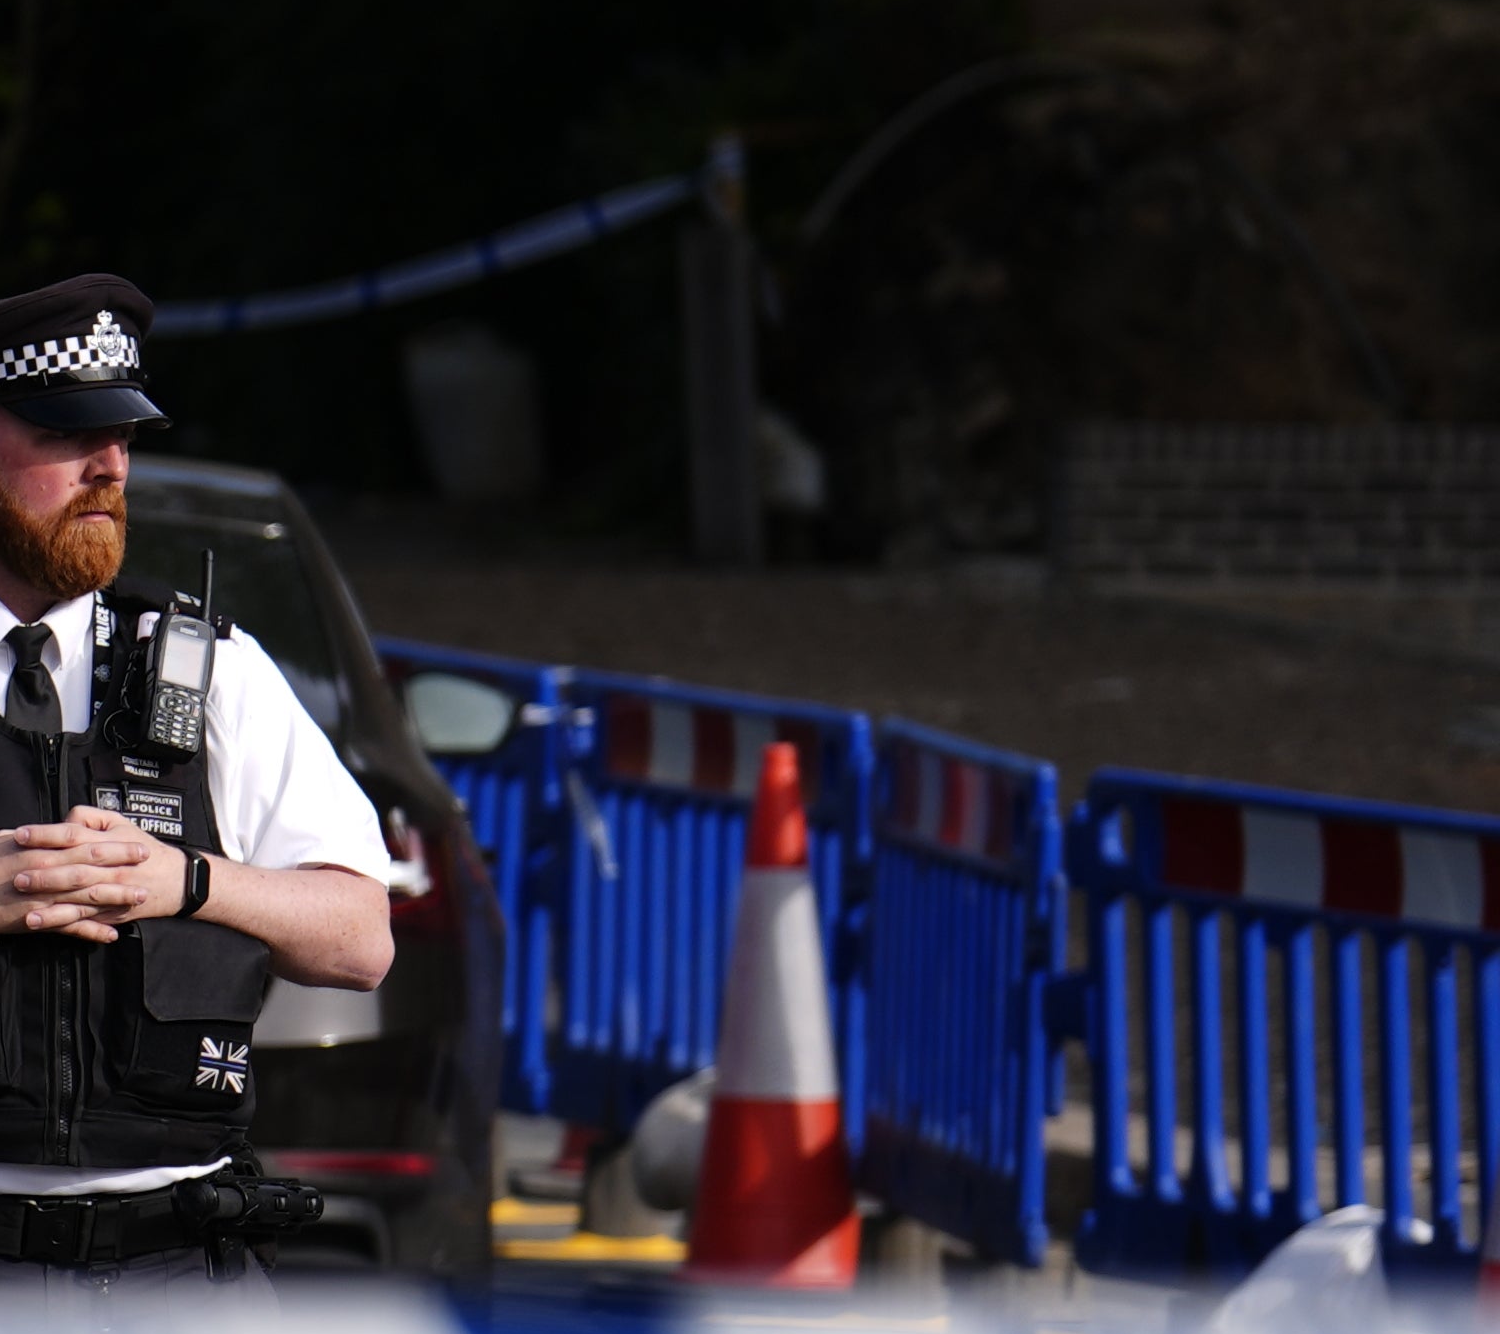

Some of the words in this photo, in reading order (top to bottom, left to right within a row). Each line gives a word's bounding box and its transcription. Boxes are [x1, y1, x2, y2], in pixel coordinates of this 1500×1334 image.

[95, 605, 110, 647] POLICE
[131, 803, 173, 816] POLICE
[140, 818, 183, 836] OFFICER
